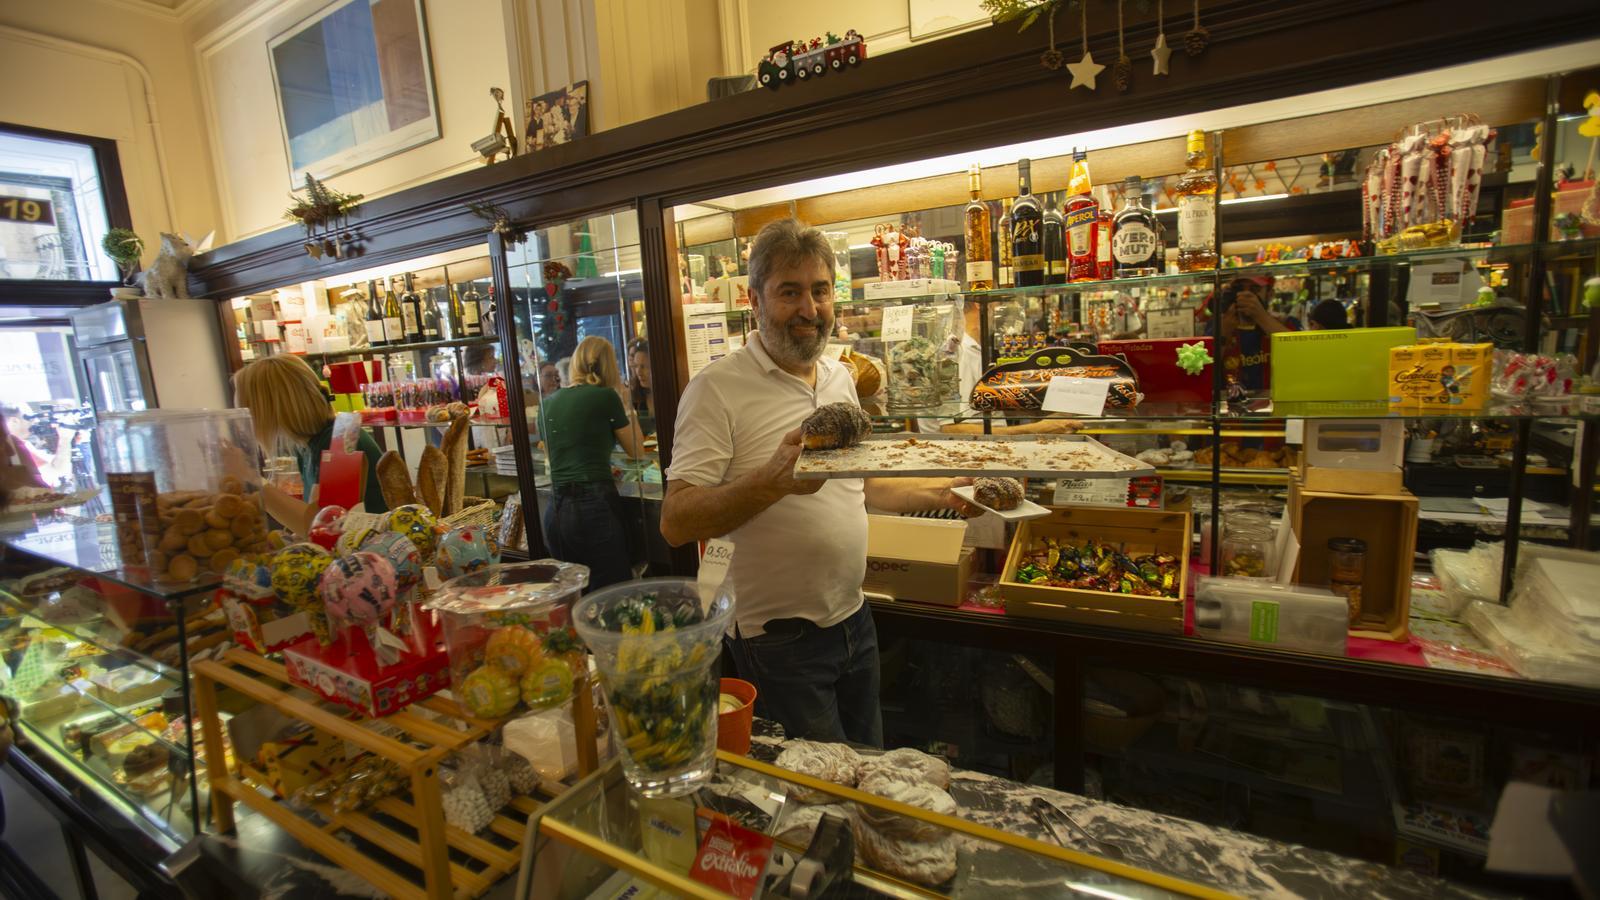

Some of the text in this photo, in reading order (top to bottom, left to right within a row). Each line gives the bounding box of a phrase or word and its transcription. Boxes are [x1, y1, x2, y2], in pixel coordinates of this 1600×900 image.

[4, 199, 41, 222] 19
[1066, 210, 1095, 227] APEROL
[1118, 232, 1150, 244] VER
[1119, 244, 1149, 257] MUT
